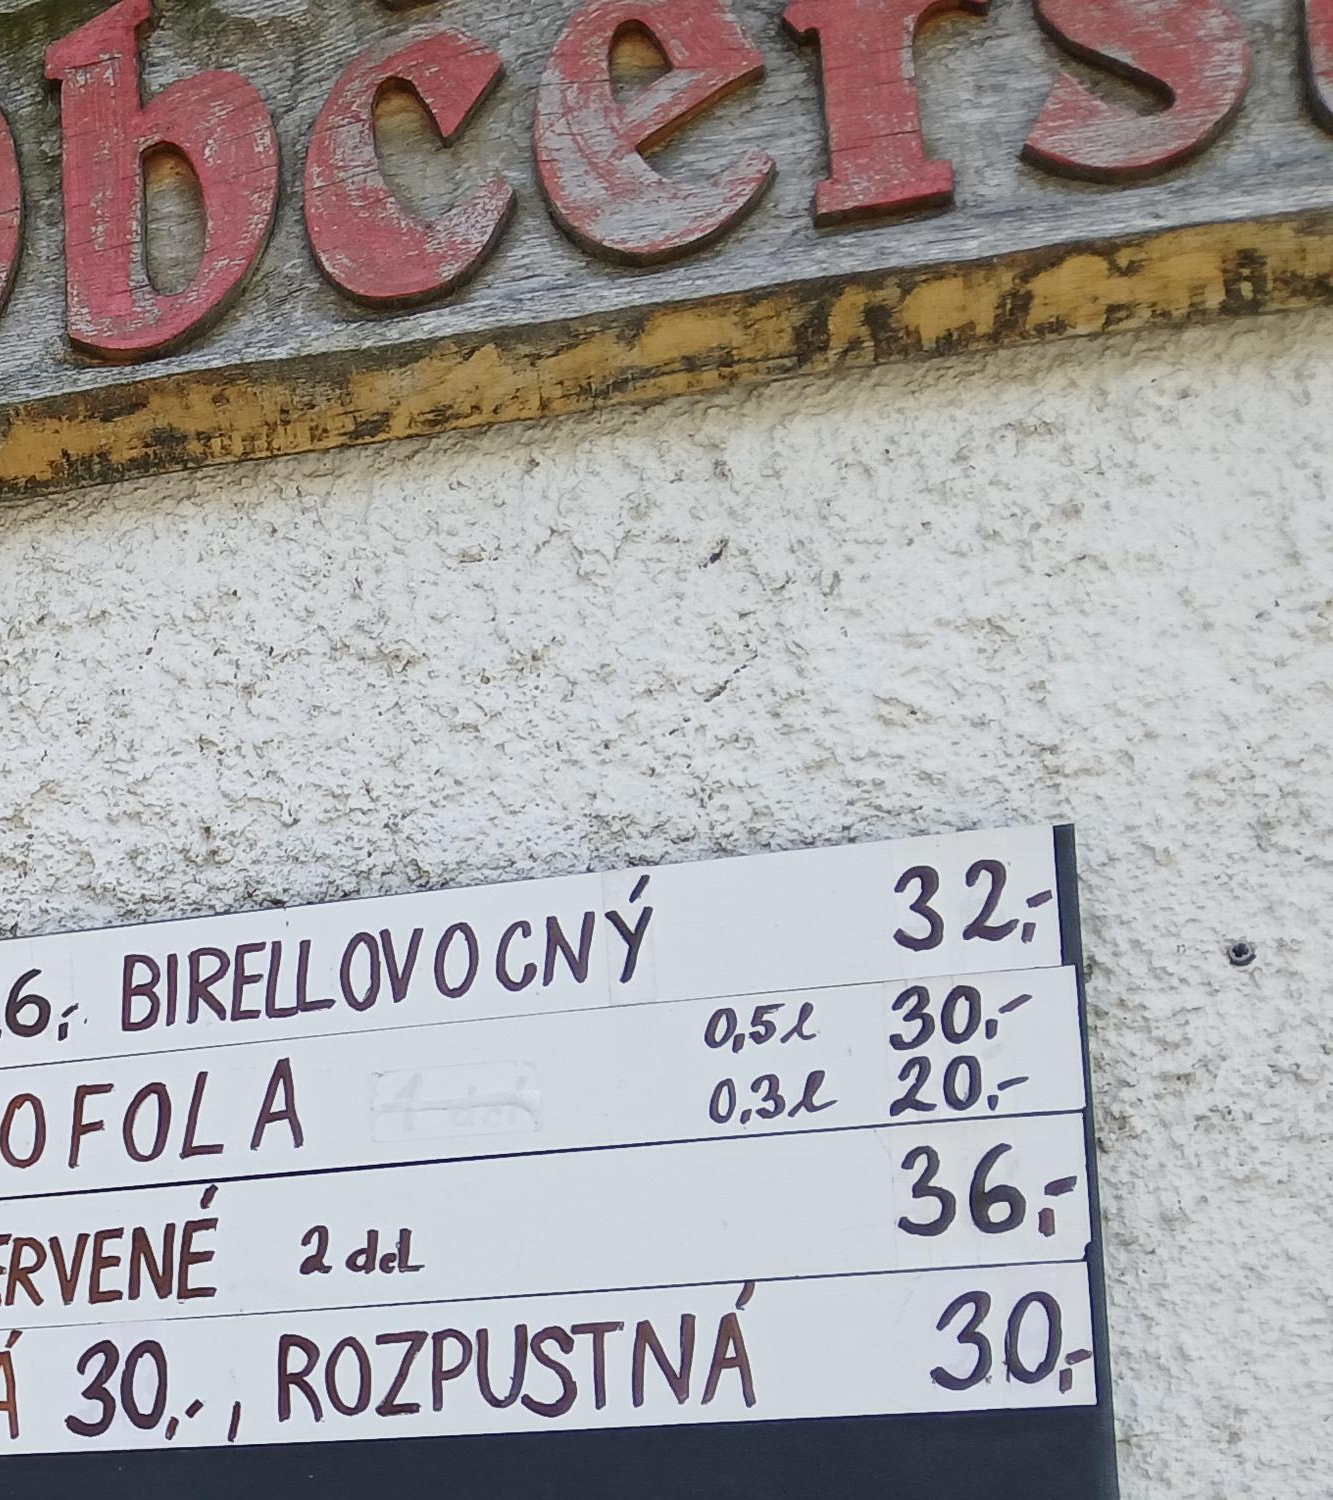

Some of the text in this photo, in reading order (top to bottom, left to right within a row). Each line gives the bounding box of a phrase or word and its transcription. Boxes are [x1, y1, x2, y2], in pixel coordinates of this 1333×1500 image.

[893, 860, 1052, 952] 32,-
[889, 985, 1032, 1050] 30,-
[890, 1056, 1029, 1117] 20,-
[898, 1143, 1077, 1237] 36,-
[277, 1281, 757, 1420] ROZPUSTNÁ
[930, 1288, 1095, 1394] 30,-
